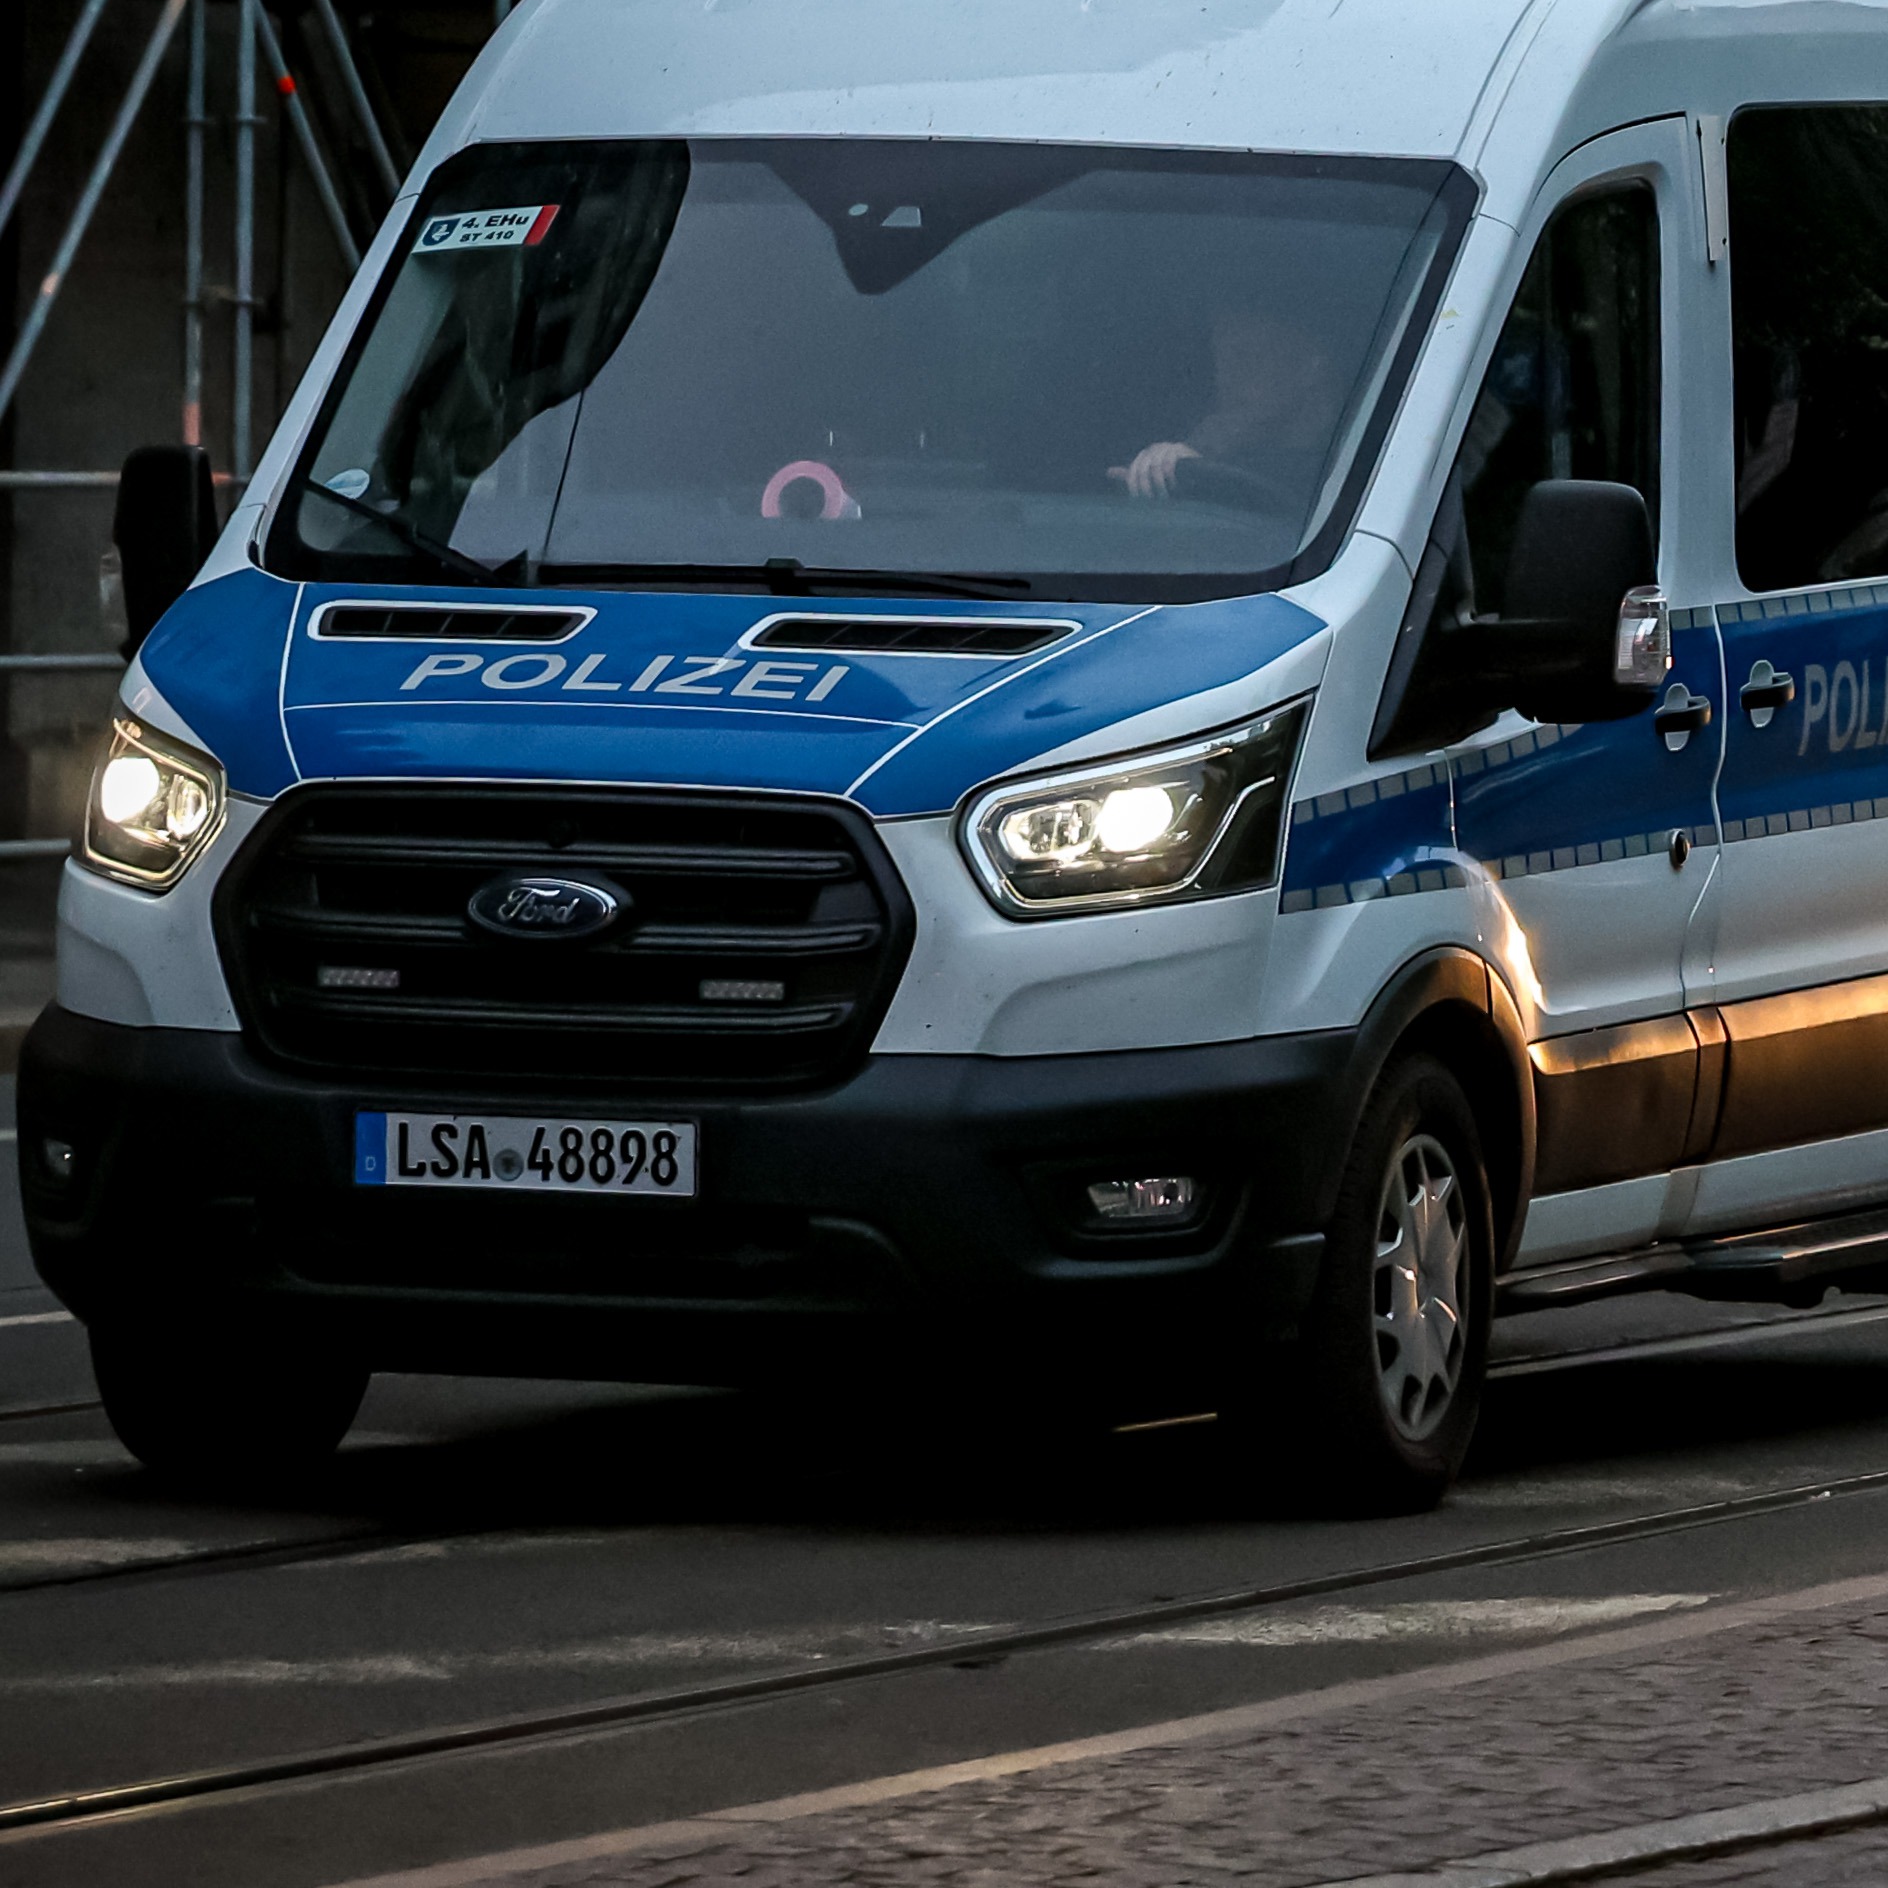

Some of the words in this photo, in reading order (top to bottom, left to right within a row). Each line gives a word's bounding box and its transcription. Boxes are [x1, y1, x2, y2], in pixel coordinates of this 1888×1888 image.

[460, 232, 481, 243] ST
[484, 229, 514, 240] 410
[462, 217, 480, 229] 4.
[484, 213, 531, 228] EHu
[399, 652, 850, 702] POLIZEI
[497, 887, 581, 924] Ford
[365, 1155, 377, 1172] D
[397, 1122, 491, 1180] LSA
[526, 1126, 680, 1186] 48898
